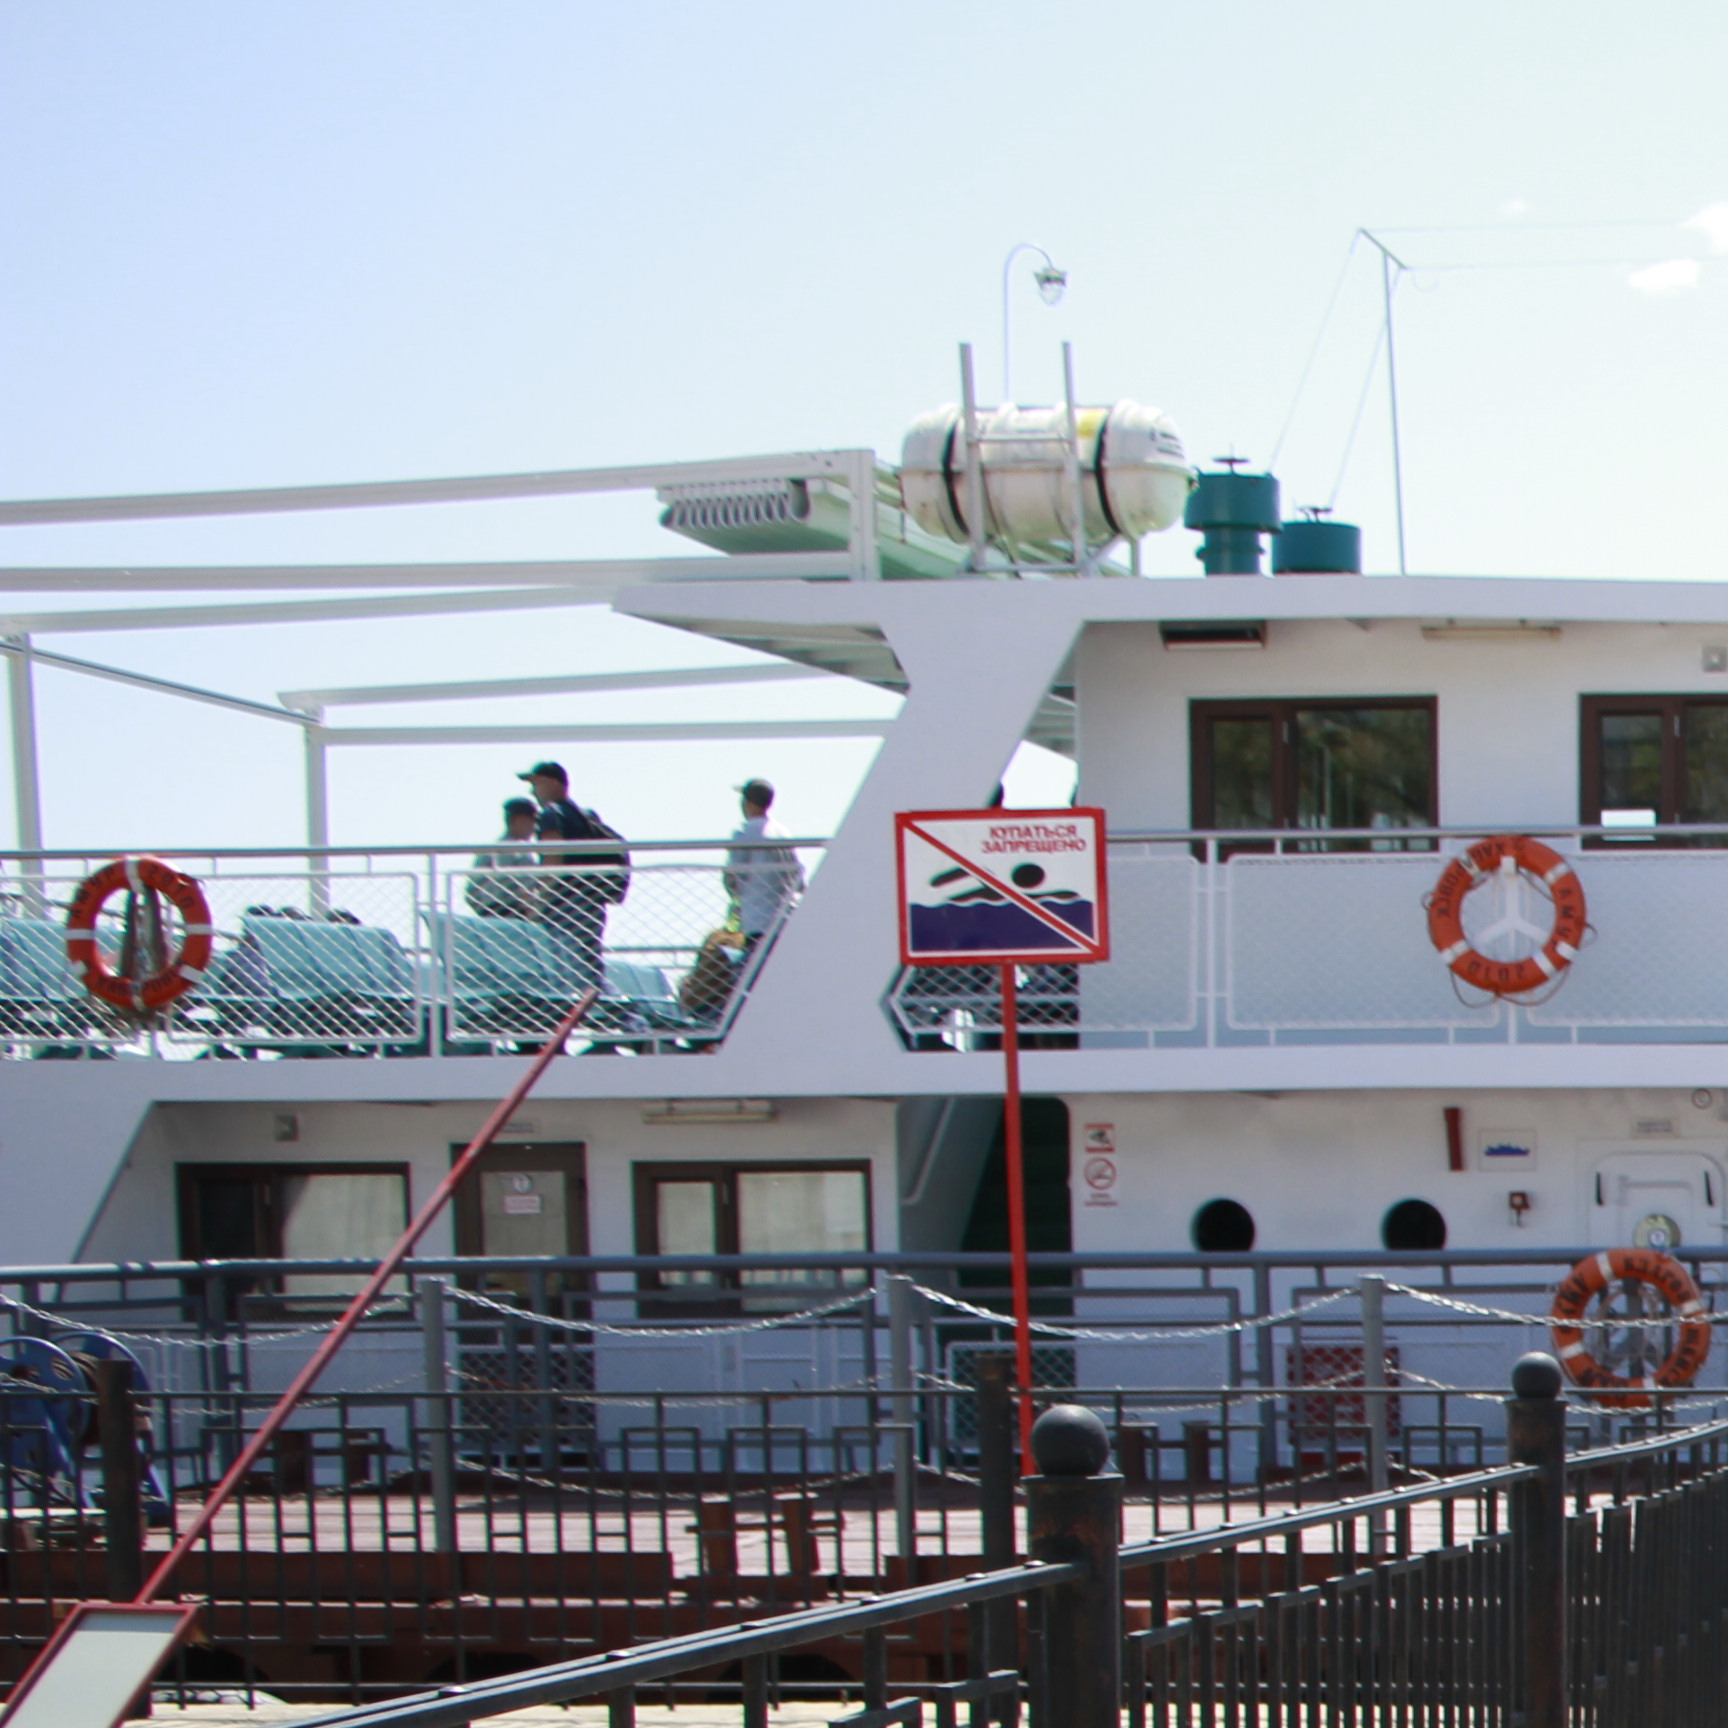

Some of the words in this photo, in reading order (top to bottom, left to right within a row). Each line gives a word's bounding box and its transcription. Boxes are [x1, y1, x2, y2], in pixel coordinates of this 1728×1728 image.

[989, 825, 1077, 839] КУПАТЬСЯ
[982, 839, 1086, 854] ЗАПРЕЩЕНО
[1465, 959, 1527, 983] 2010
